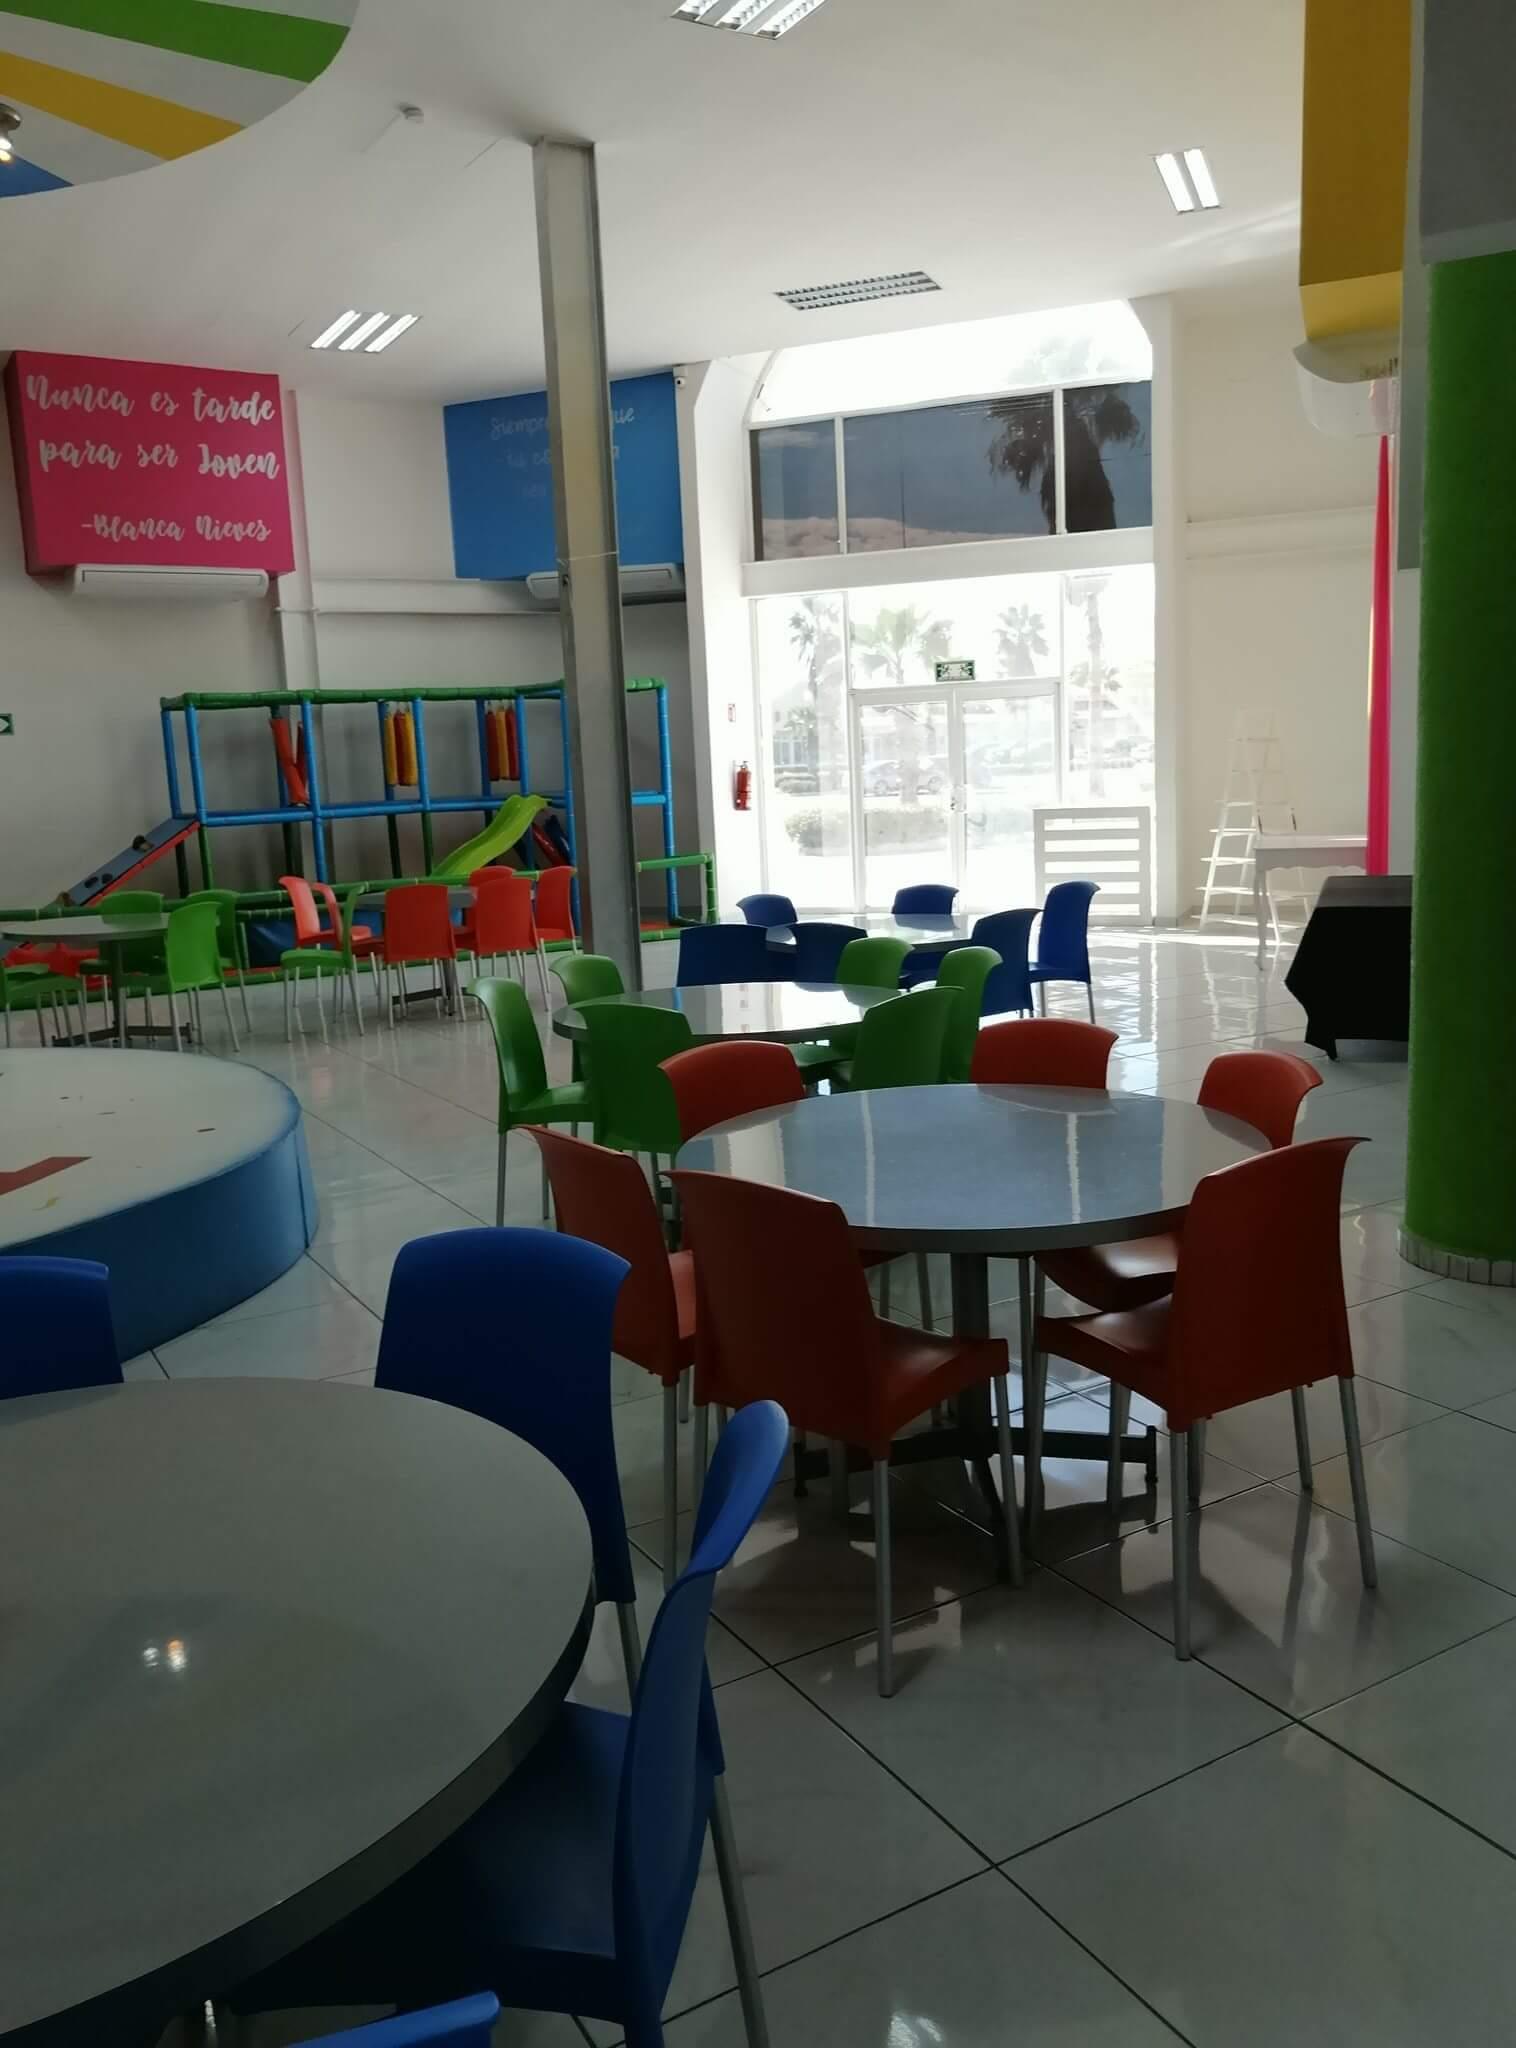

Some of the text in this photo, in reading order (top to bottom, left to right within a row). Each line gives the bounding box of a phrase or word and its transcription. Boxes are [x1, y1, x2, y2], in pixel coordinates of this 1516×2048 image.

[26, 375, 276, 426] Nunca es tarde
[38, 439, 280, 480] para ser Joven
[195, 515, 272, 542] Nieves
